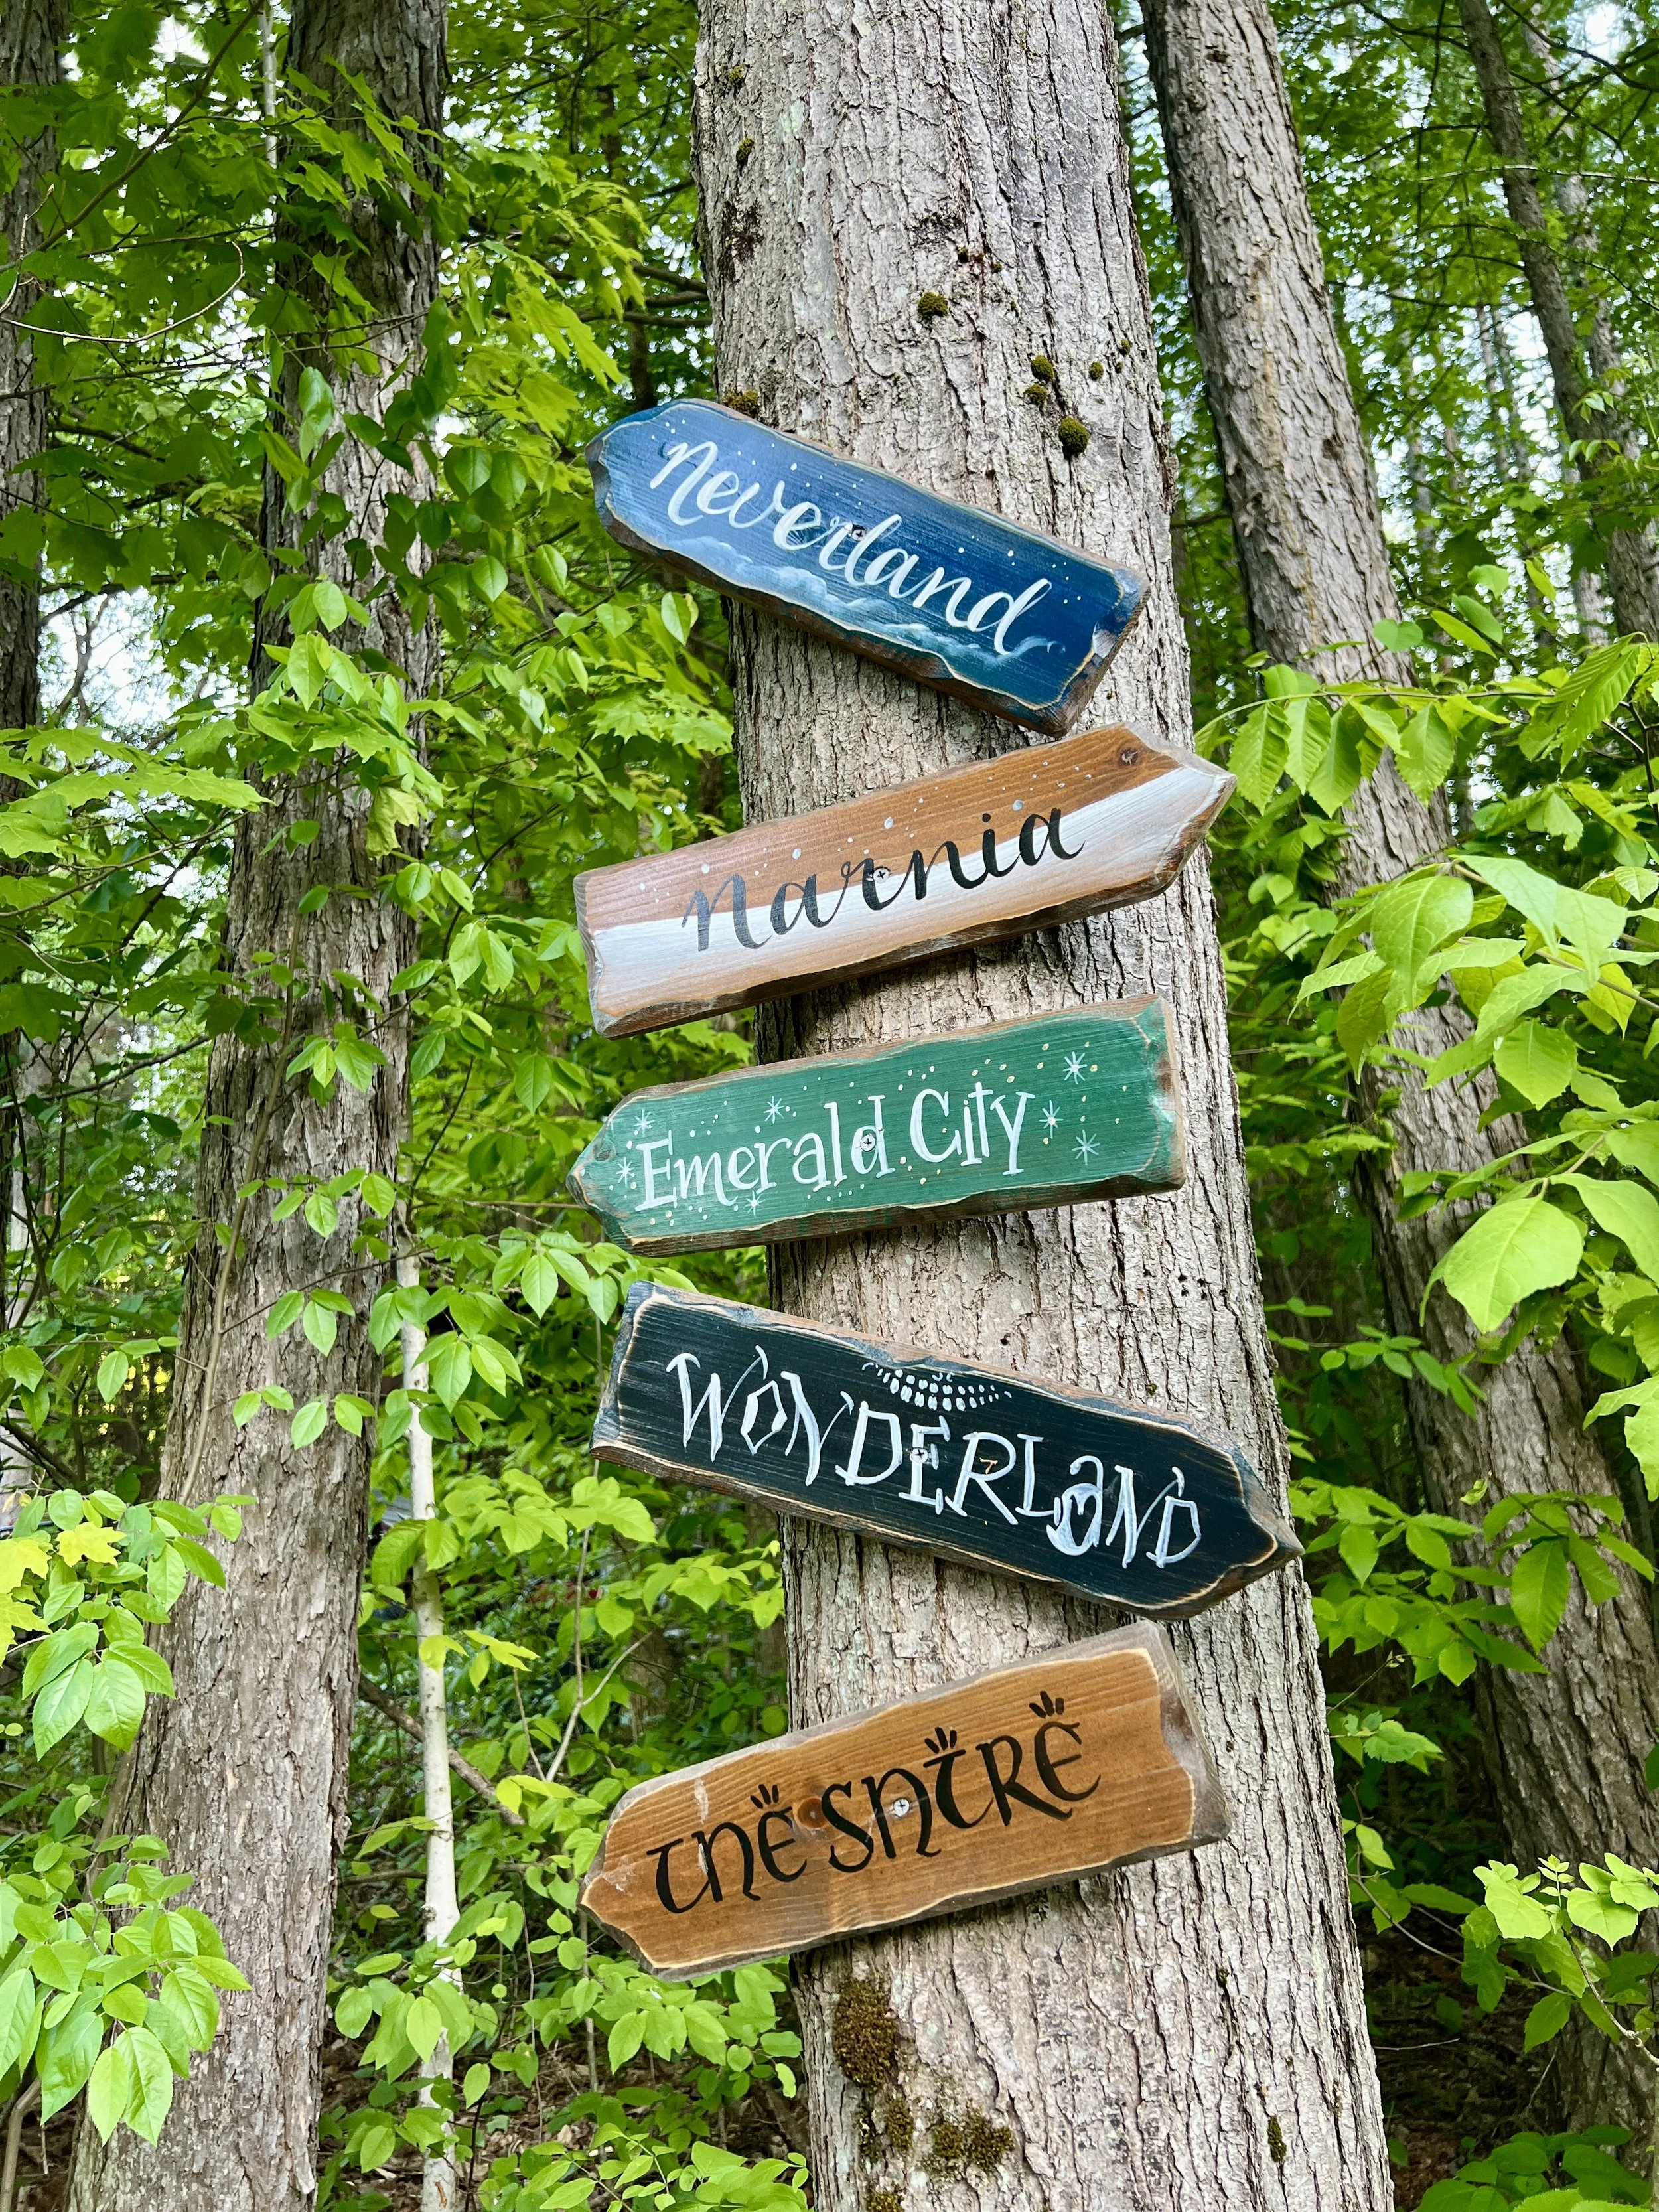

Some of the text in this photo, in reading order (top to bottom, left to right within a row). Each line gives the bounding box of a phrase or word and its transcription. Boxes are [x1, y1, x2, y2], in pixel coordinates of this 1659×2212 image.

[650, 441, 1052, 655] Neverland
[682, 807, 1085, 952] Narnia
[634, 1082, 1035, 1211] Emerald City
